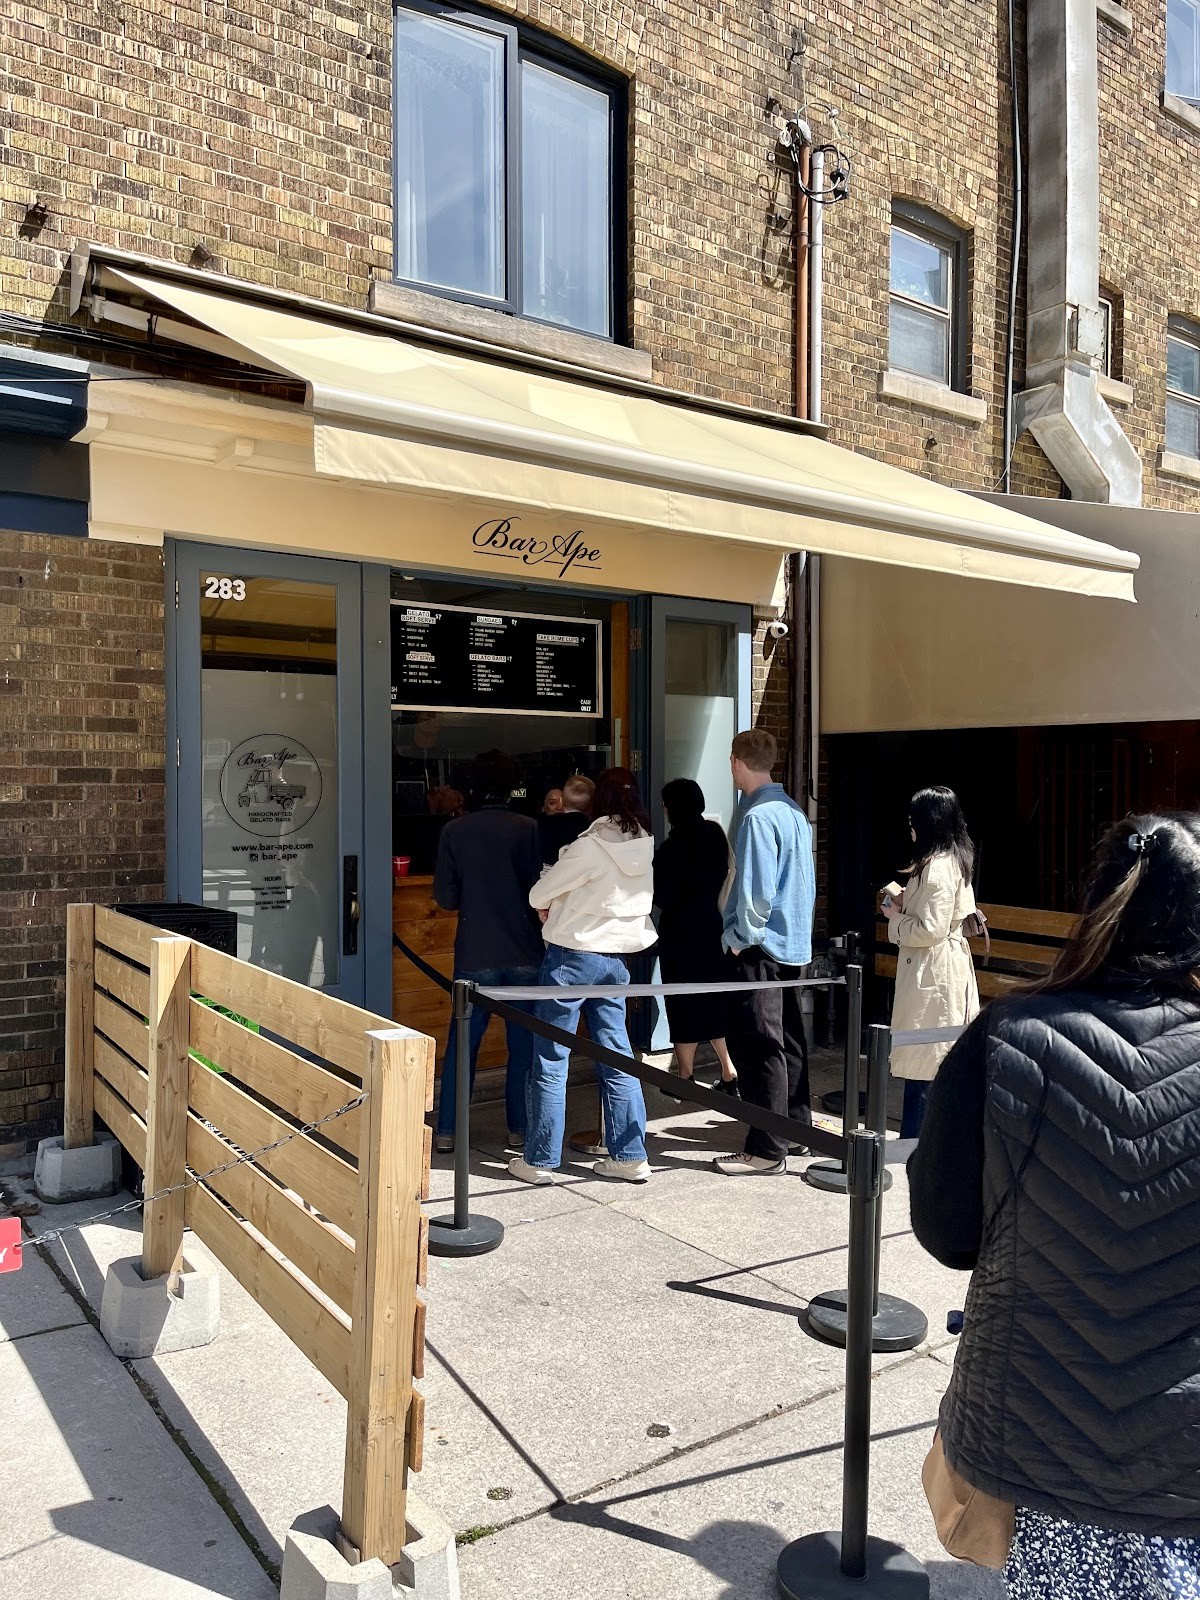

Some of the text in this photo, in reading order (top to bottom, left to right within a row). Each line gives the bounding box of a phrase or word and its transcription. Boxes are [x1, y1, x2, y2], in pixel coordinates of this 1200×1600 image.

[472, 516, 602, 578] Bar Ape
[205, 576, 246, 601] 283
[407, 609, 430, 617] GELATO
[417, 616, 436, 624] SERVE
[477, 616, 502, 624] SUNDAES
[238, 747, 298, 769] Bar Ape
[511, 788, 525, 796] NLY
[232, 843, 314, 852] www.bar-ape.com
[262, 852, 298, 861] bar_ape
